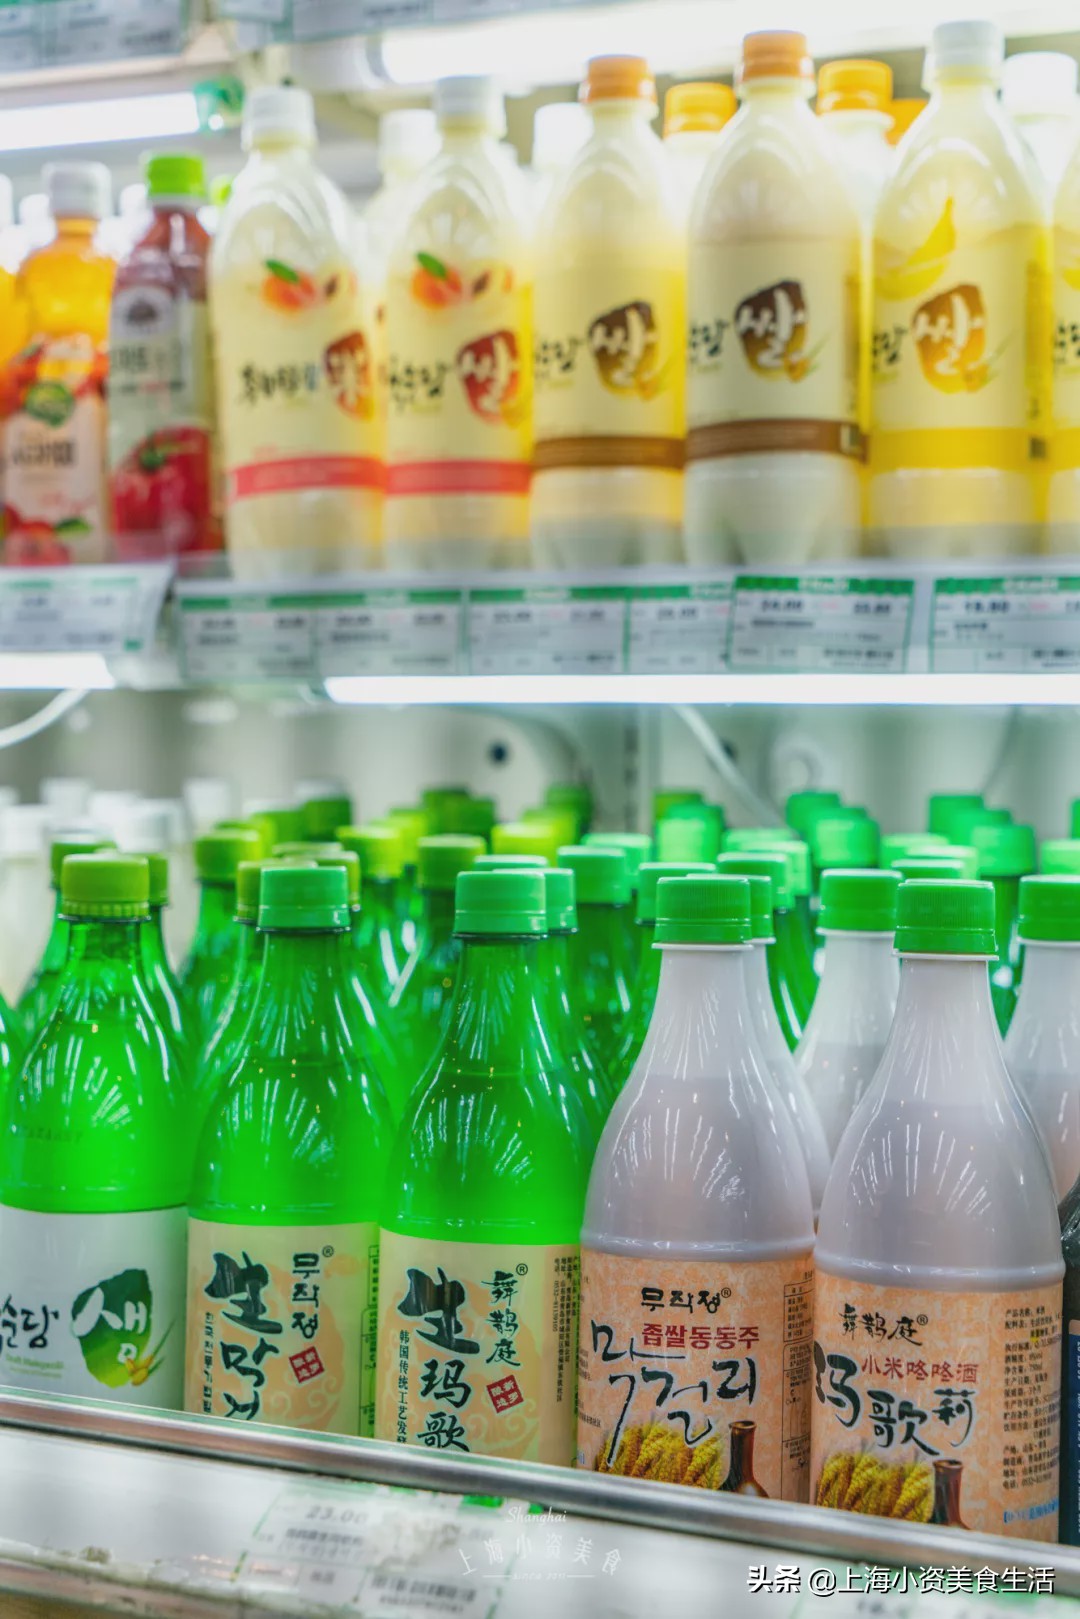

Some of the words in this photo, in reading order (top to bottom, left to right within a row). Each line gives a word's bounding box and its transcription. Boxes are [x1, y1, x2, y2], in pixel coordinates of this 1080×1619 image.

[641, 1287, 721, 1314] 무작정
[641, 1325, 760, 1353] 좁쌀동동주
[860, 1354, 980, 1384] 小米咚咚酒
[590, 1319, 757, 1467] 막걸리
